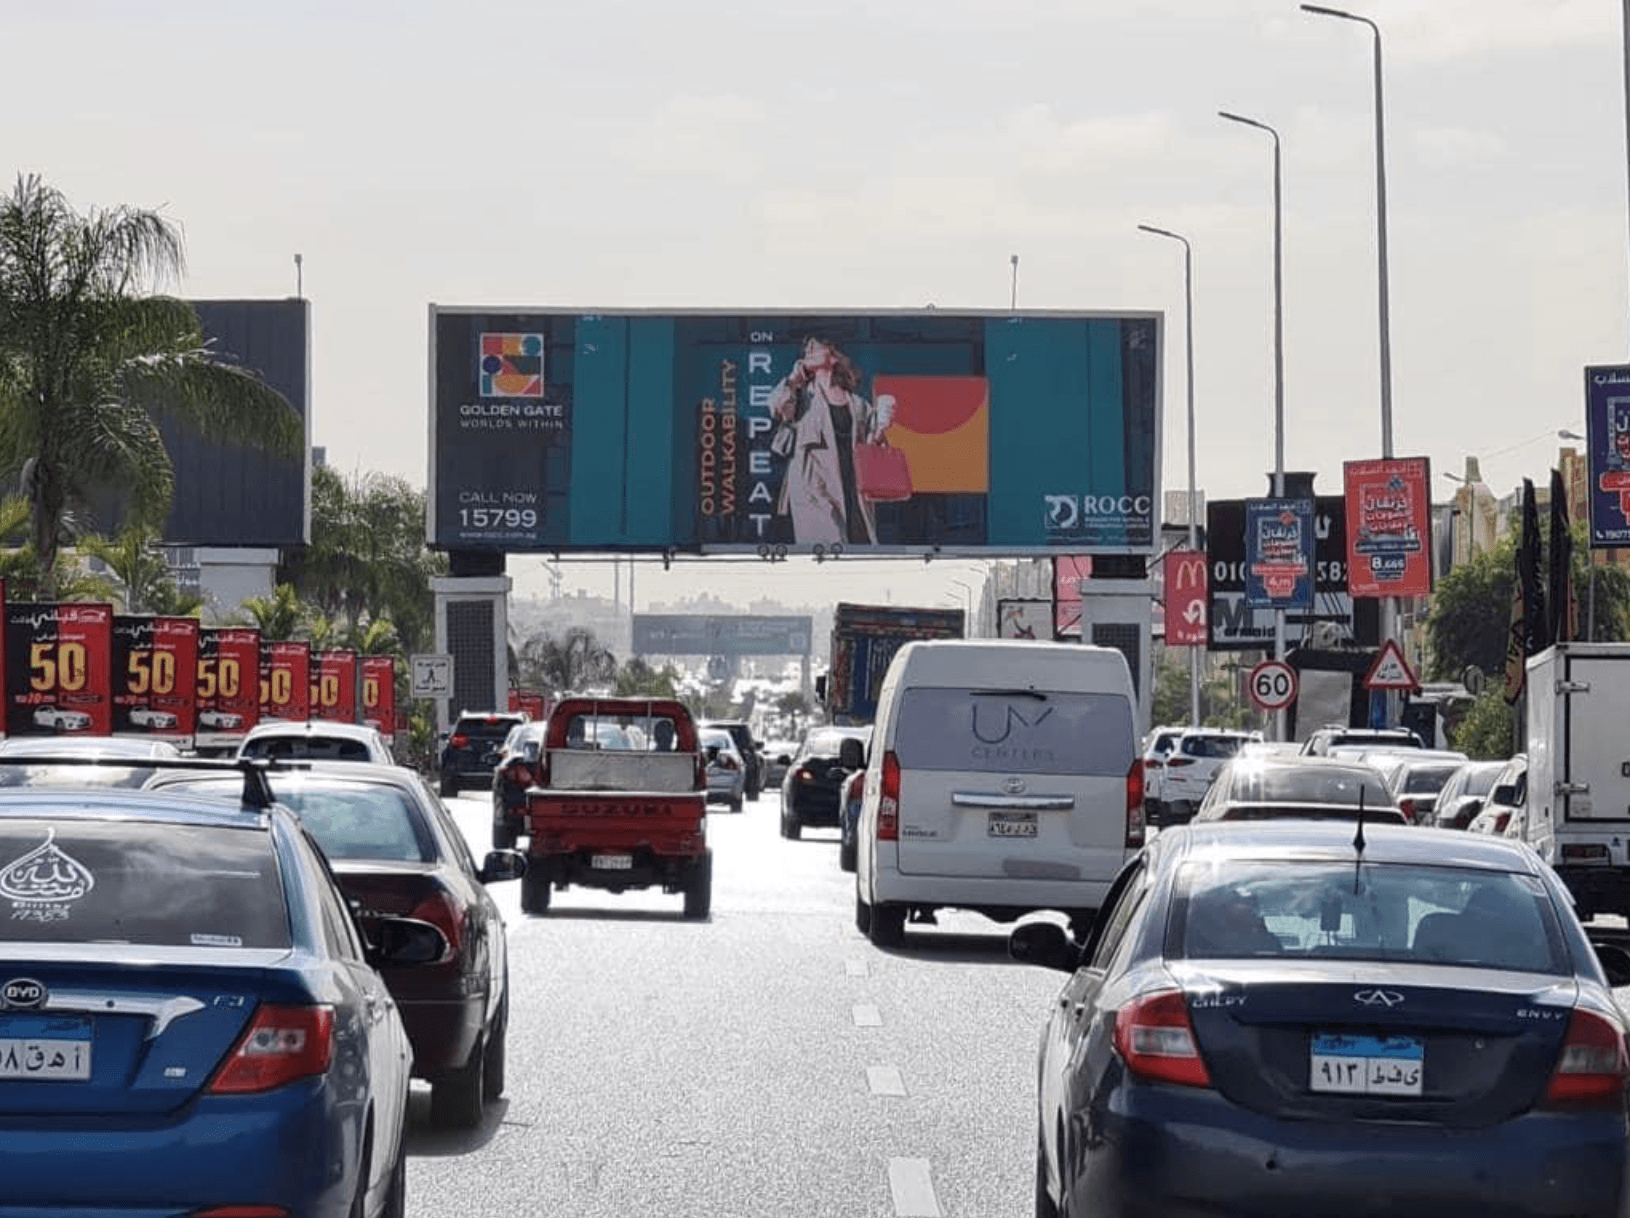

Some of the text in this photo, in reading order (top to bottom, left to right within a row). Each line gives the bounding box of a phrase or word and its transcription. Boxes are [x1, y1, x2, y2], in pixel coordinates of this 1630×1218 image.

[750, 331, 774, 343] ON
[460, 404, 563, 417] GOLDEN GATE
[460, 419, 563, 429] WORLDS WITHIN
[721, 359, 738, 516] WALKABILITY
[701, 397, 717, 516] OUTDOOR
[459, 491, 538, 503] CALL NOW
[1084, 495, 1151, 515] ROCC
[460, 509, 537, 528] 15799
[1317, 561, 1347, 582] 58
[30, 642, 85, 691] 50
[128, 651, 174, 693] 50
[1257, 673, 1289, 696] 60
[561, 803, 674, 816] SUZUKI
[7, 985, 40, 998] BYD
[1517, 1009, 1563, 1021] ENVY
